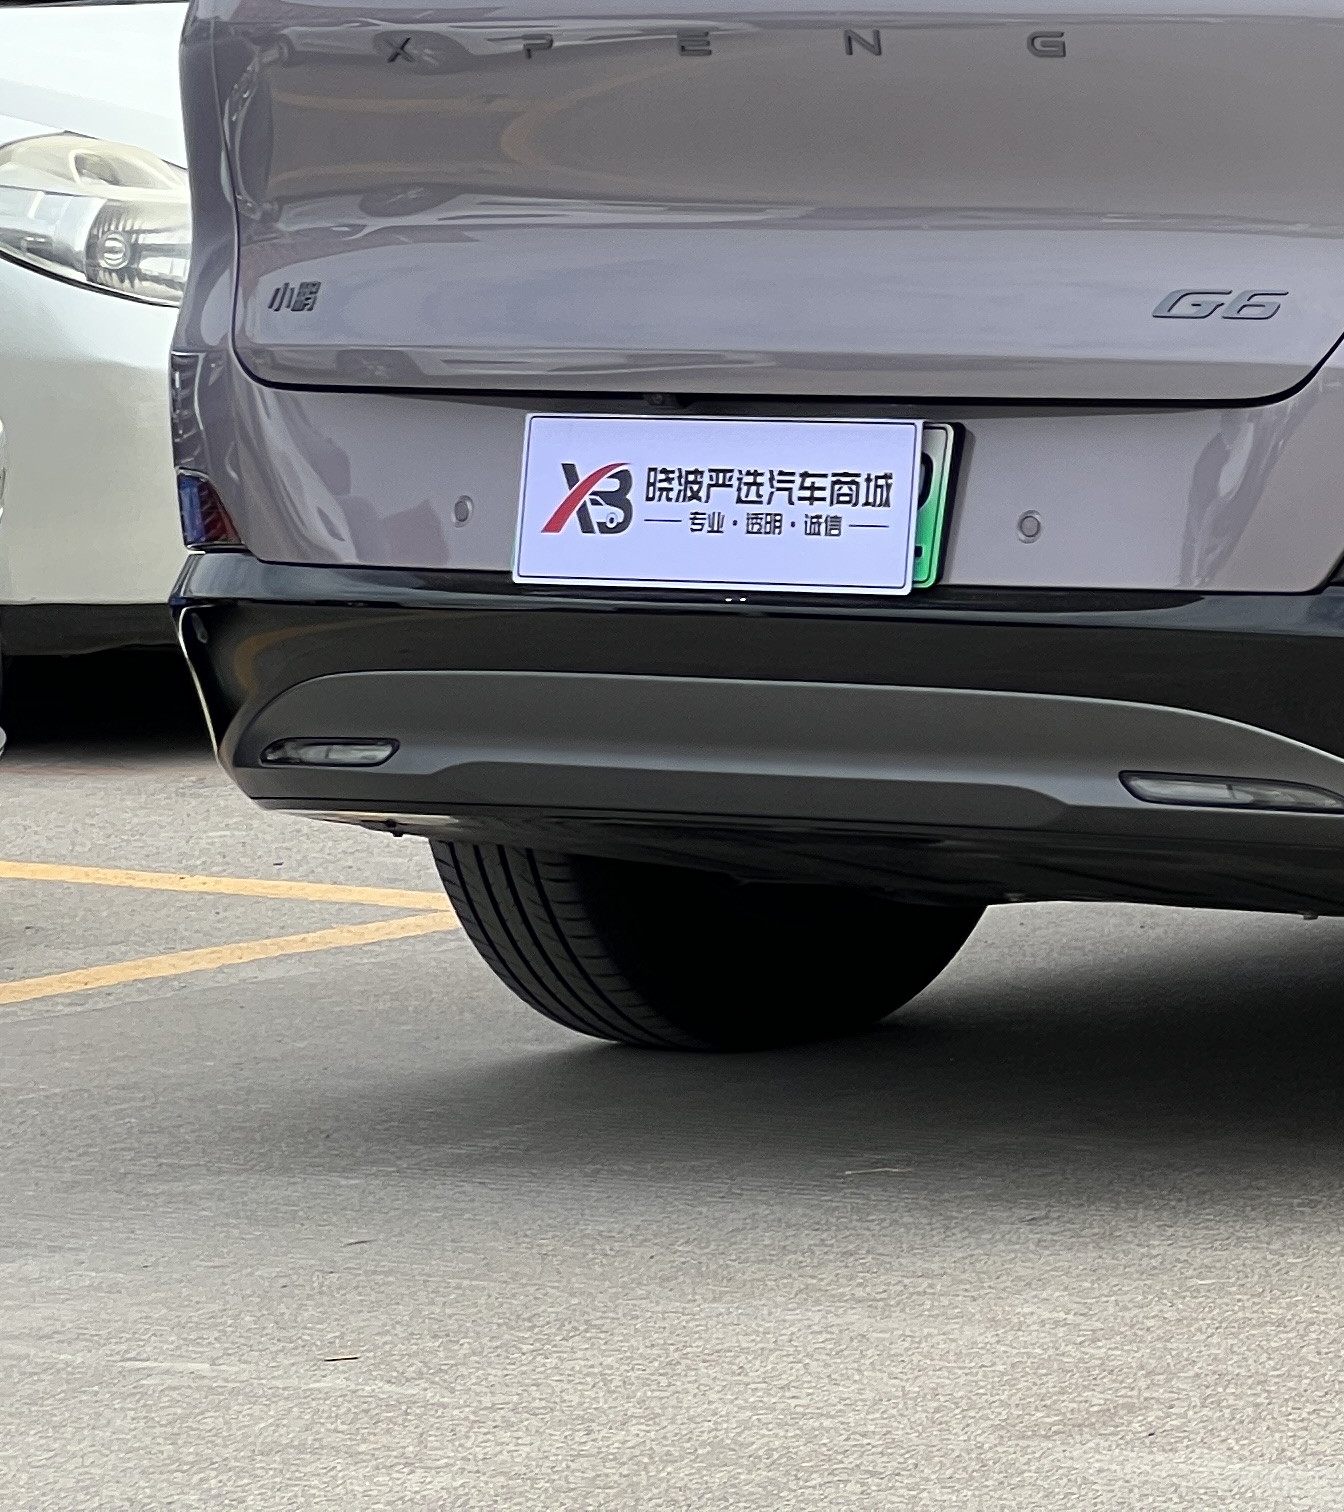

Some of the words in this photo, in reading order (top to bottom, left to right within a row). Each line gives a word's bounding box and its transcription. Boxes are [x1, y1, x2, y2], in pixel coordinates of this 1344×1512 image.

[267, 281, 322, 312] 小鹏
[1151, 289, 1290, 320] G6
[644, 466, 894, 509] 晓波严选汽车商城
